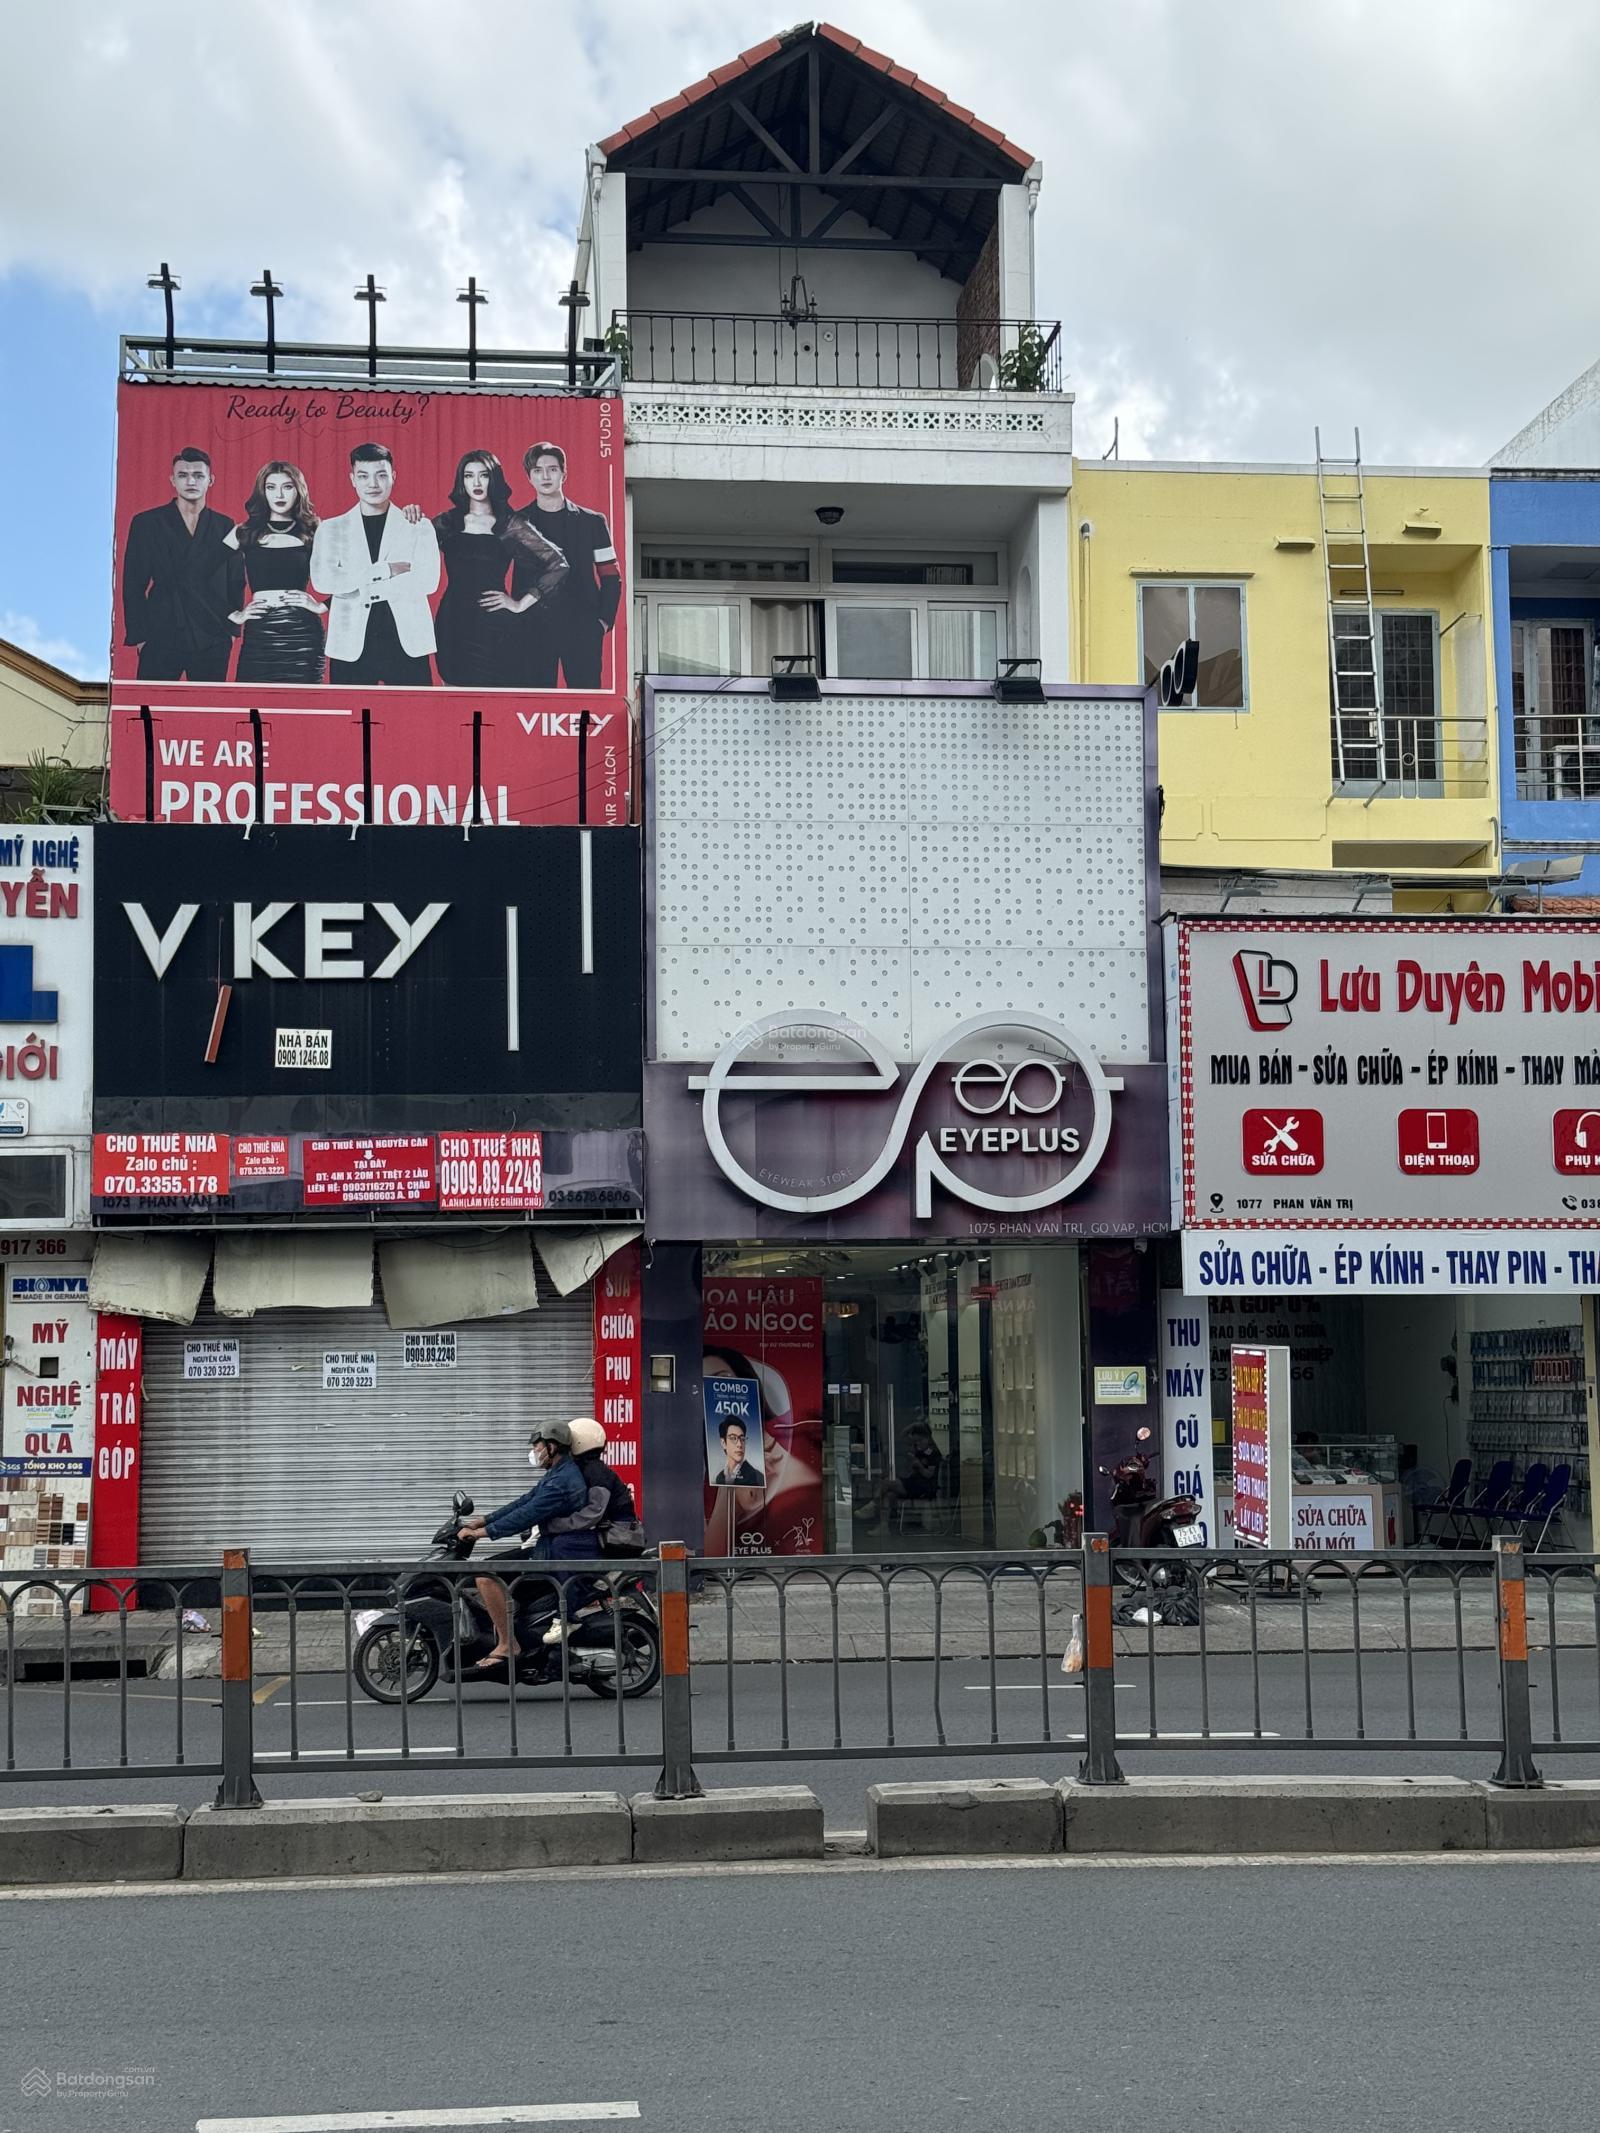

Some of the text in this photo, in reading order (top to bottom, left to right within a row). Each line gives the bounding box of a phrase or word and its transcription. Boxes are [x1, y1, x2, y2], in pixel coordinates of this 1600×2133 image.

[227, 395, 430, 423] Ready to Beauty?
[600, 402, 611, 457] STUDIO
[159, 739, 204, 766] WE
[605, 745, 616, 797] SALON
[160, 780, 521, 824] PROFESSIONAL
[32, 836, 79, 873] NGHỆ
[1319, 959, 1381, 1013] Lưu
[1396, 959, 1506, 1026] Duyên
[279, 1031, 328, 1048] NHÀ BÁN
[278, 1049, 329, 1066] 0909.1246.08
[1210, 1055, 1251, 1085] MUA
[1259, 1048, 1293, 1085] BÁN
[1313, 1045, 1348, 1086] SỬA
[1357, 1048, 1403, 1086] CHỮA
[1427, 1049, 1449, 1086] ÉP
[1457, 1049, 1499, 1086] KÍNH
[1522, 1055, 1564, 1086] THAY
[106, 1134, 217, 1153] CHO THUÊ NHÀ
[238, 1143, 252, 1153] CHO
[271, 1140, 285, 1153] NHÀ
[312, 1141, 330, 1151] CHO
[440, 1134, 541, 1157] CHO THUÊ NHÀ
[938, 1127, 1081, 1153] EYEPLUS
[126, 1155, 188, 1171] Zalo chủ
[245, 1157, 263, 1165] Zalo
[1251, 1151, 1316, 1167] SỬA CHỮA
[1404, 1152, 1475, 1169] ĐIỆN THOẠI
[1564, 1155, 1592, 1169] PHỤ
[104, 1176, 218, 1194] 070.3355.178
[355, 1171, 373, 1180] 20M
[441, 1159, 541, 1195] 0909.89.2248
[759, 1167, 814, 1188] EYEWEAR
[1236, 1199, 1263, 1210] 1077
[1273, 1199, 1305, 1210] PHAN
[1310, 1197, 1333, 1210] VĂN
[968, 1223, 996, 1234] 1075
[1000, 1223, 1031, 1234] PHAN
[1035, 1223, 1059, 1234] VAN
[1091, 1223, 1109, 1234] GO
[1113, 1223, 1138, 1236] VAP,
[1143, 1222, 1169, 1233] HCM
[0, 1239, 66, 1255] 917 366
[1200, 1239, 1547, 1286] SỬA CHỮA ÉP KÍNH THAY PIN
[702, 1285, 794, 1308] OA HẬU
[32, 1318, 69, 1344] MỸ
[601, 1308, 635, 1339] CHỮA
[745, 1312, 814, 1334] NGỌC
[1167, 1318, 1200, 1347] THU
[187, 1343, 200, 1352] CHO
[223, 1340, 237, 1351] NHÀ
[405, 1335, 420, 1345] CHO
[441, 1333, 455, 1345] NHÀ
[100, 1332, 138, 1370] MÁY
[325, 1354, 339, 1364] CHO
[361, 1352, 375, 1363] NHÀ
[405, 1347, 455, 1362] 0909.89.2248
[188, 1365, 236, 1377] 070 320 3223
[605, 1356, 631, 1385] PHỤ
[1166, 1362, 1204, 1397] MÁY
[326, 1377, 373, 1387] 070 320 3223
[713, 1382, 749, 1394] COMBO
[101, 1382, 136, 1425] TRẢ
[604, 1394, 633, 1427] KIỆN
[715, 1401, 749, 1417] 450K
[1176, 1414, 1199, 1448] CŨ
[98, 1440, 135, 1480] GÓP
[1174, 1464, 1204, 1499] GIÁ
[1297, 1504, 1367, 1527] SỬA CHỮA
[751, 1547, 772, 1555] PLUS
